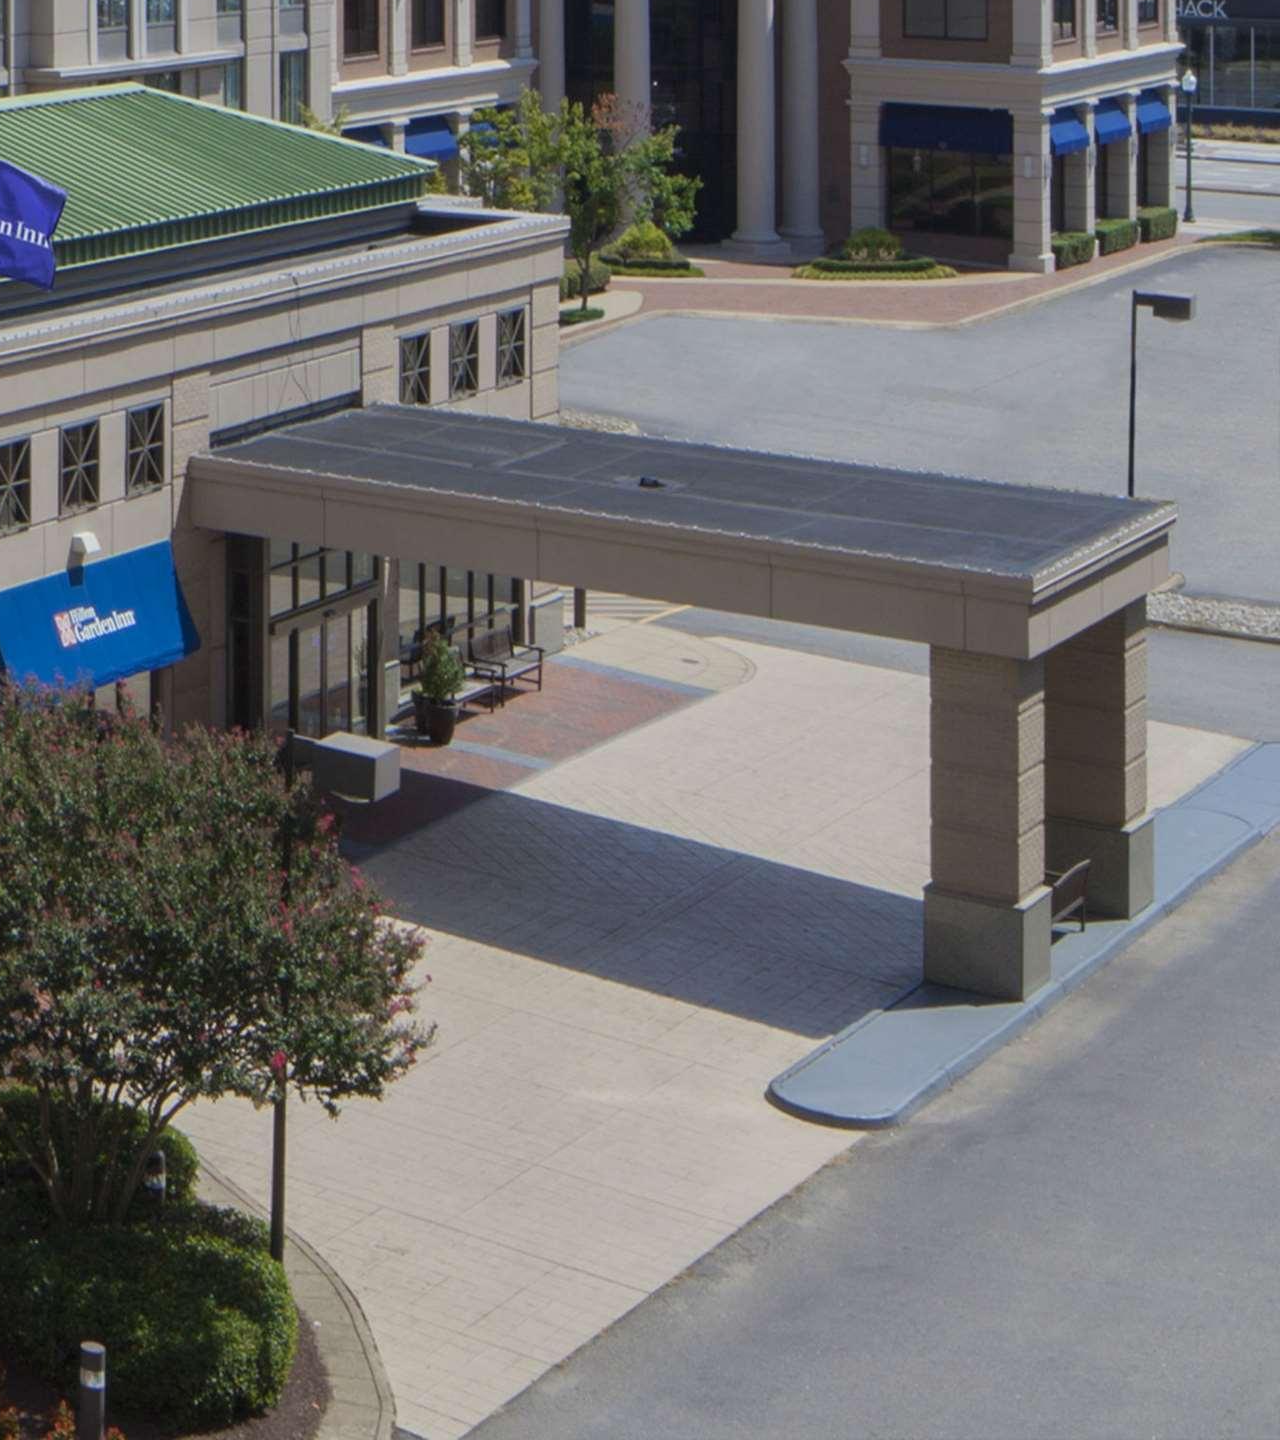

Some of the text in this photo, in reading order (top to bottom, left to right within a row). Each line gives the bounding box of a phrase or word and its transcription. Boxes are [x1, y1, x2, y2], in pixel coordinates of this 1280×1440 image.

[16, 221, 49, 248] Inn
[74, 610, 136, 642] Garden Inn
